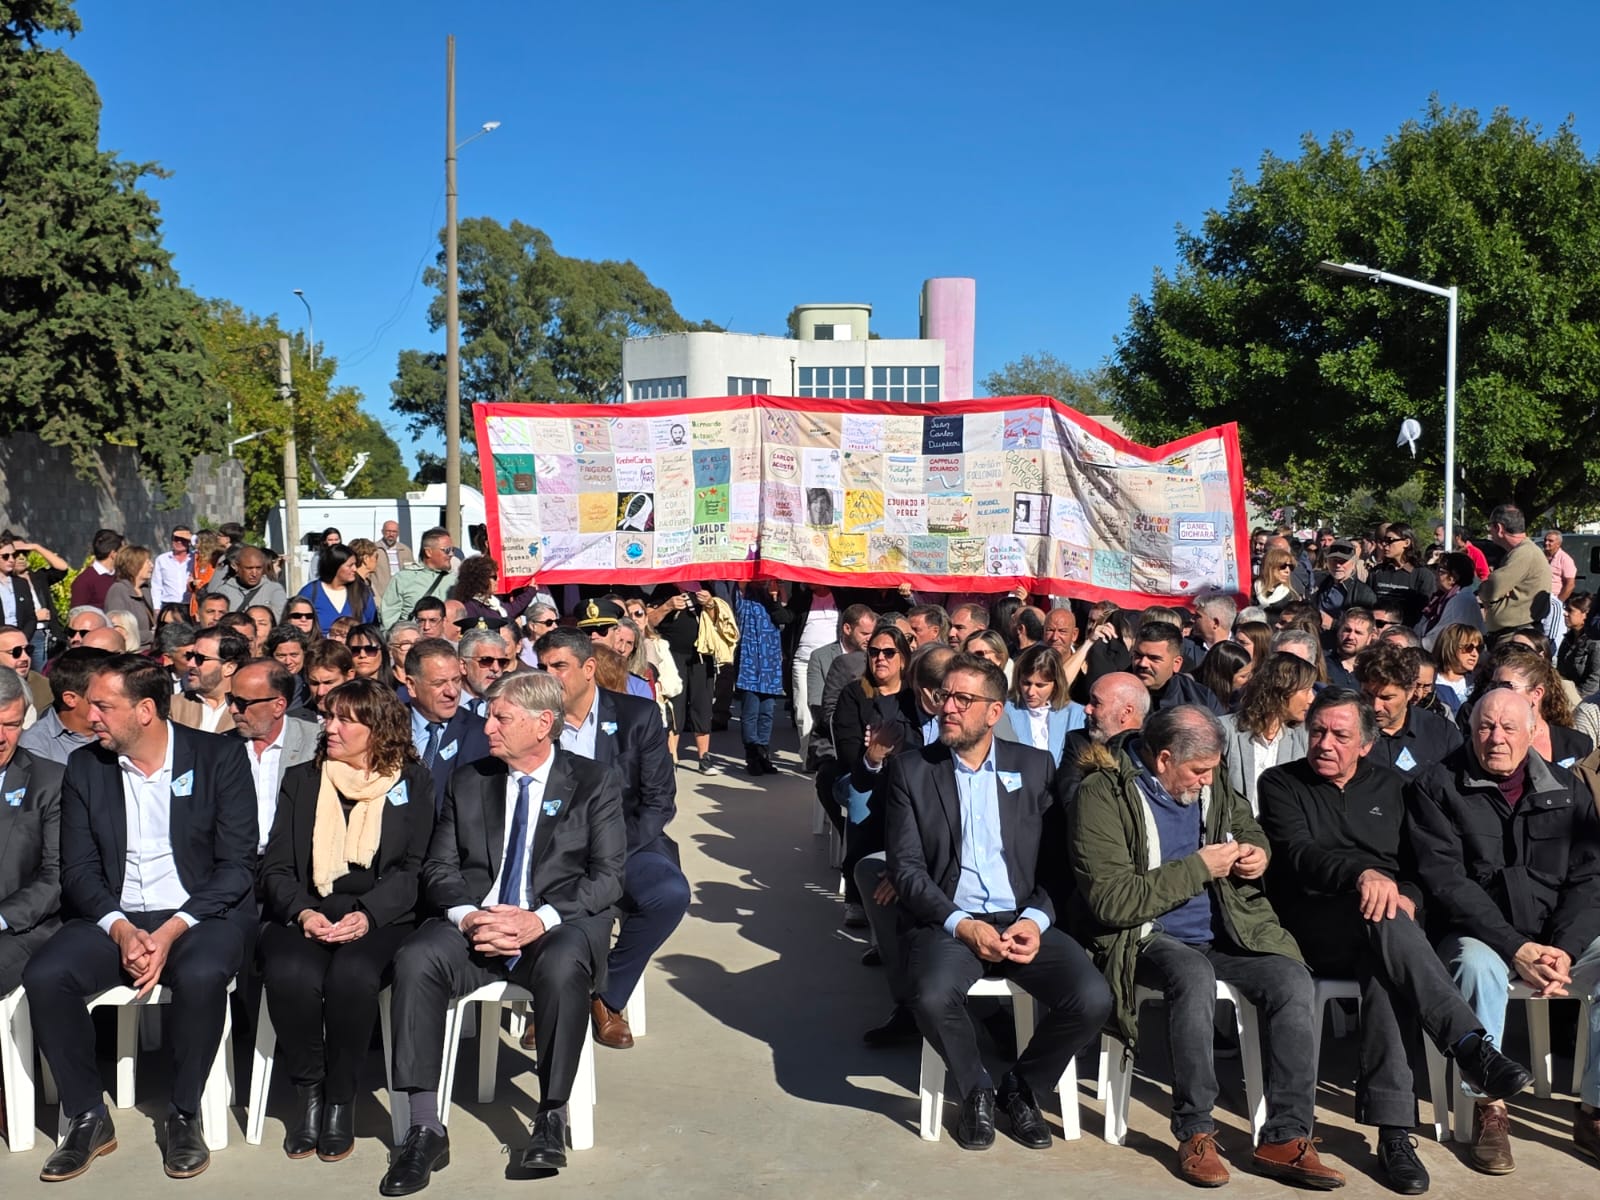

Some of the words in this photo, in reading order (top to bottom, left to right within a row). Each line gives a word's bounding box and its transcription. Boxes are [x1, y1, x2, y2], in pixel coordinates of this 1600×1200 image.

[929, 430, 954, 438] Carlos
[772, 453, 795, 462] CARLOS
[772, 461, 794, 470] ACOSTA
[887, 498, 918, 506] EDUARDO
[976, 508, 1010, 516] ALEJANDRO
